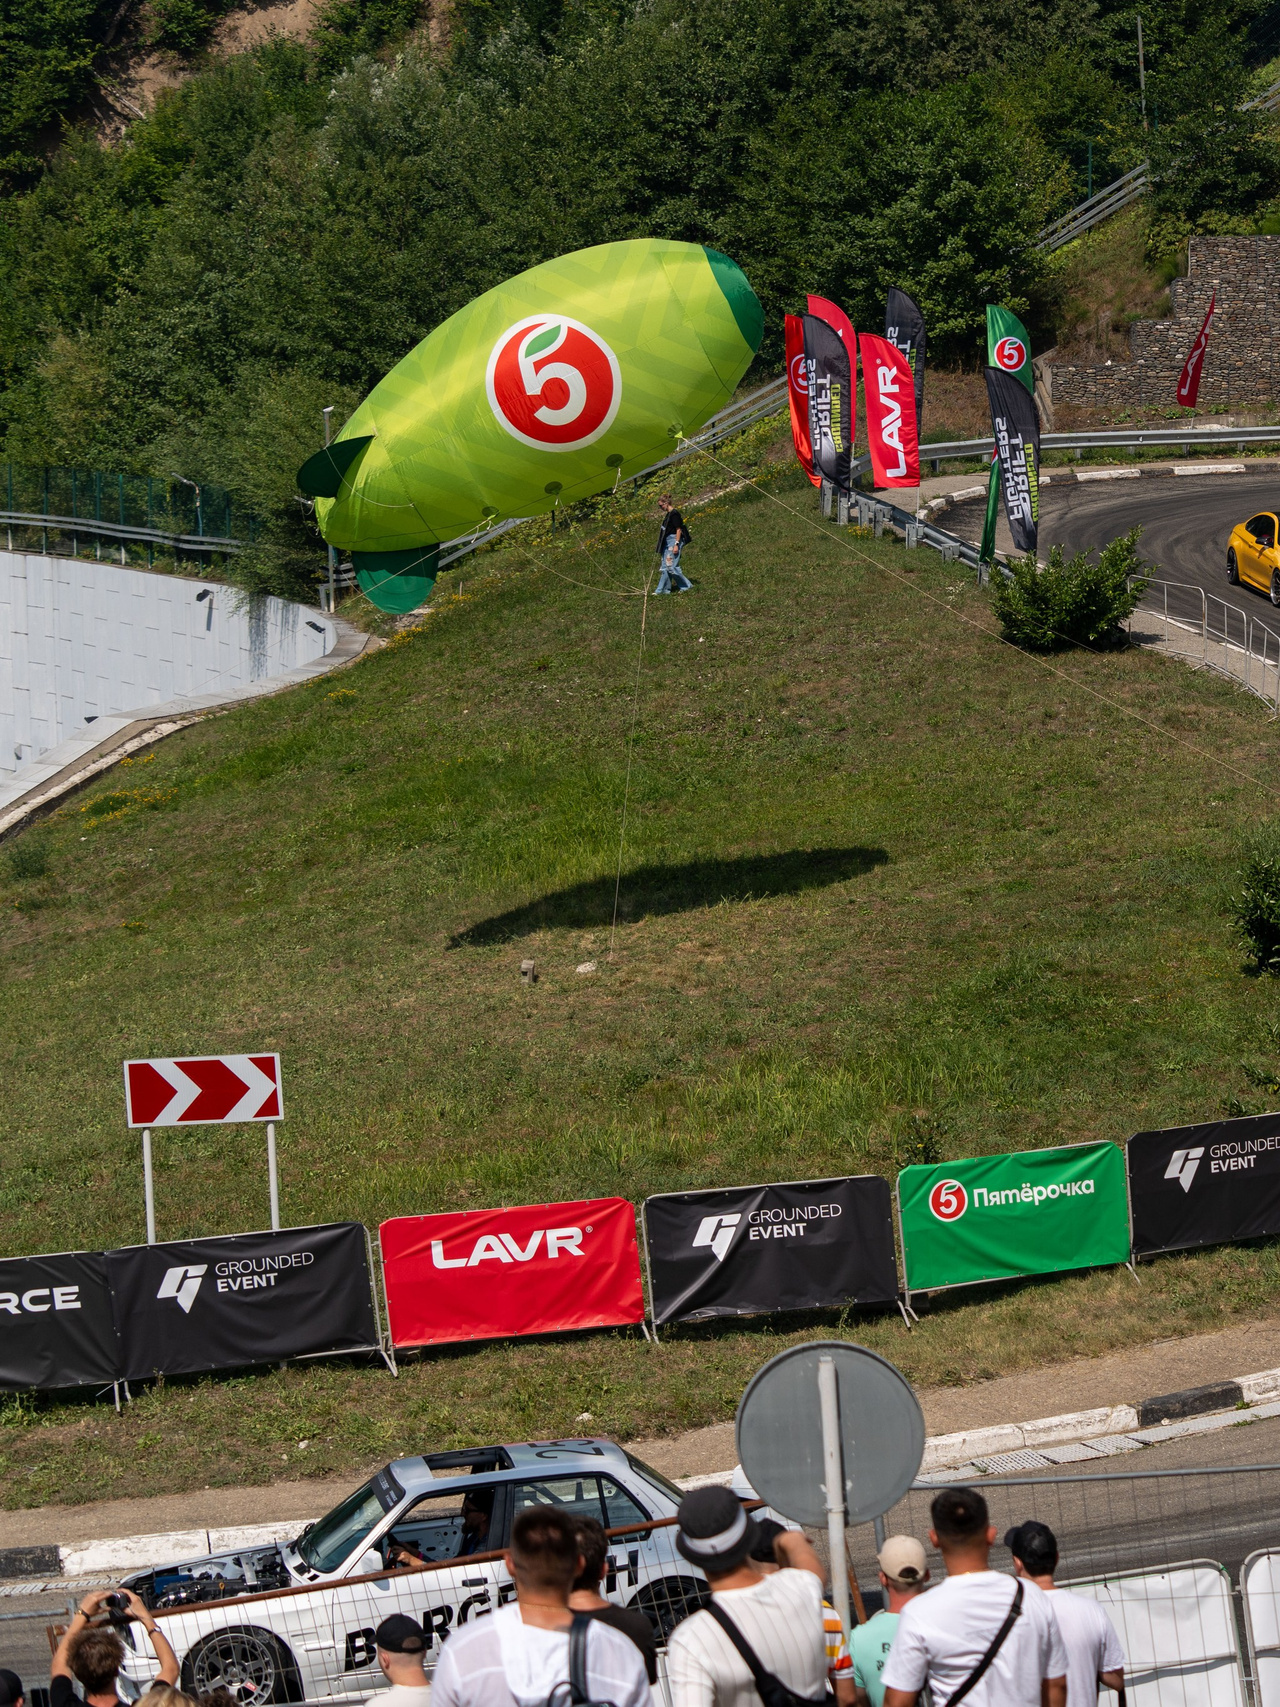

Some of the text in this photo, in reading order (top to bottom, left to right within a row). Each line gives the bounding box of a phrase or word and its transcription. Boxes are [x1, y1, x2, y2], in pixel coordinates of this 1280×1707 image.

[518, 320, 586, 426] 5
[1210, 1155, 1257, 1173] EVENT
[973, 1179, 1095, 1208] Пятёрочка
[748, 1203, 842, 1224] GROUNDED
[749, 1223, 807, 1241] EVENT
[215, 1252, 314, 1276] GROUNDED
[217, 1272, 278, 1293] EVENT
